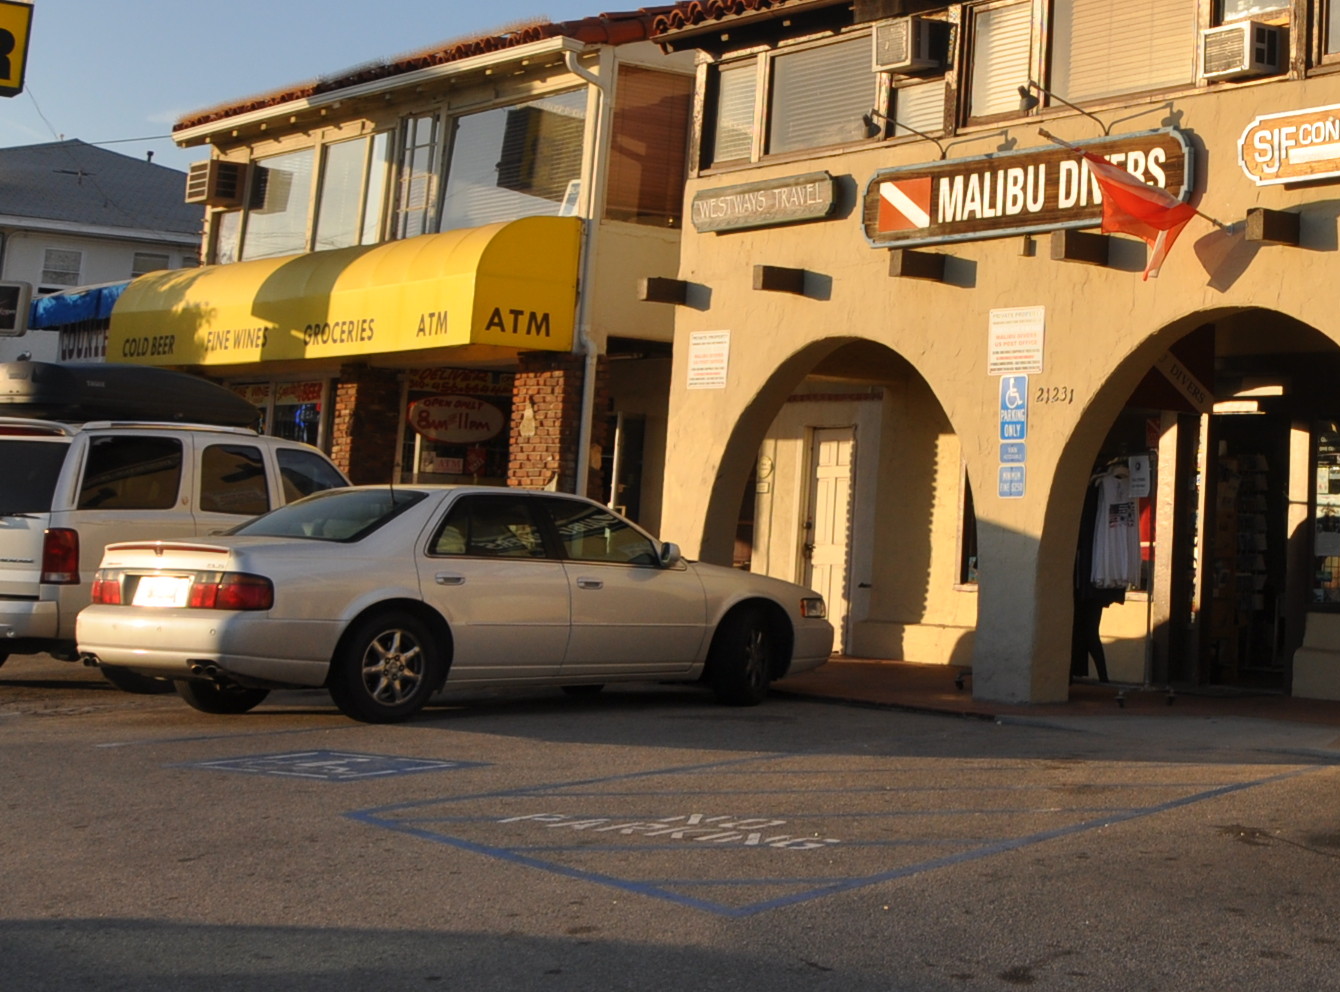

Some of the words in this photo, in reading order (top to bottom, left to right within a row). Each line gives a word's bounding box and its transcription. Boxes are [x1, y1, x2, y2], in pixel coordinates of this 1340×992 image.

[1253, 125, 1297, 174] SJF
[695, 190, 766, 219] WESTWAYS
[773, 182, 823, 208] TRAVEL
[937, 163, 1046, 224] MALIBU
[303, 318, 375, 346] GROCERIES
[416, 310, 448, 338] ATM
[485, 307, 550, 337] ATM
[122, 337, 148, 359] COLD
[150, 334, 176, 356] BEER
[205, 330, 230, 352] FINE
[232, 326, 269, 349] WINES
[1036, 386, 1075, 405] 21231
[1169, 363, 1207, 405] DIVERS
[423, 398, 452, 408] OPEN
[1001, 408, 1025, 421] PARKING
[1004, 424, 1021, 437] ONLY
[497, 813, 842, 850] PARKING
[657, 813, 787, 829] NO
